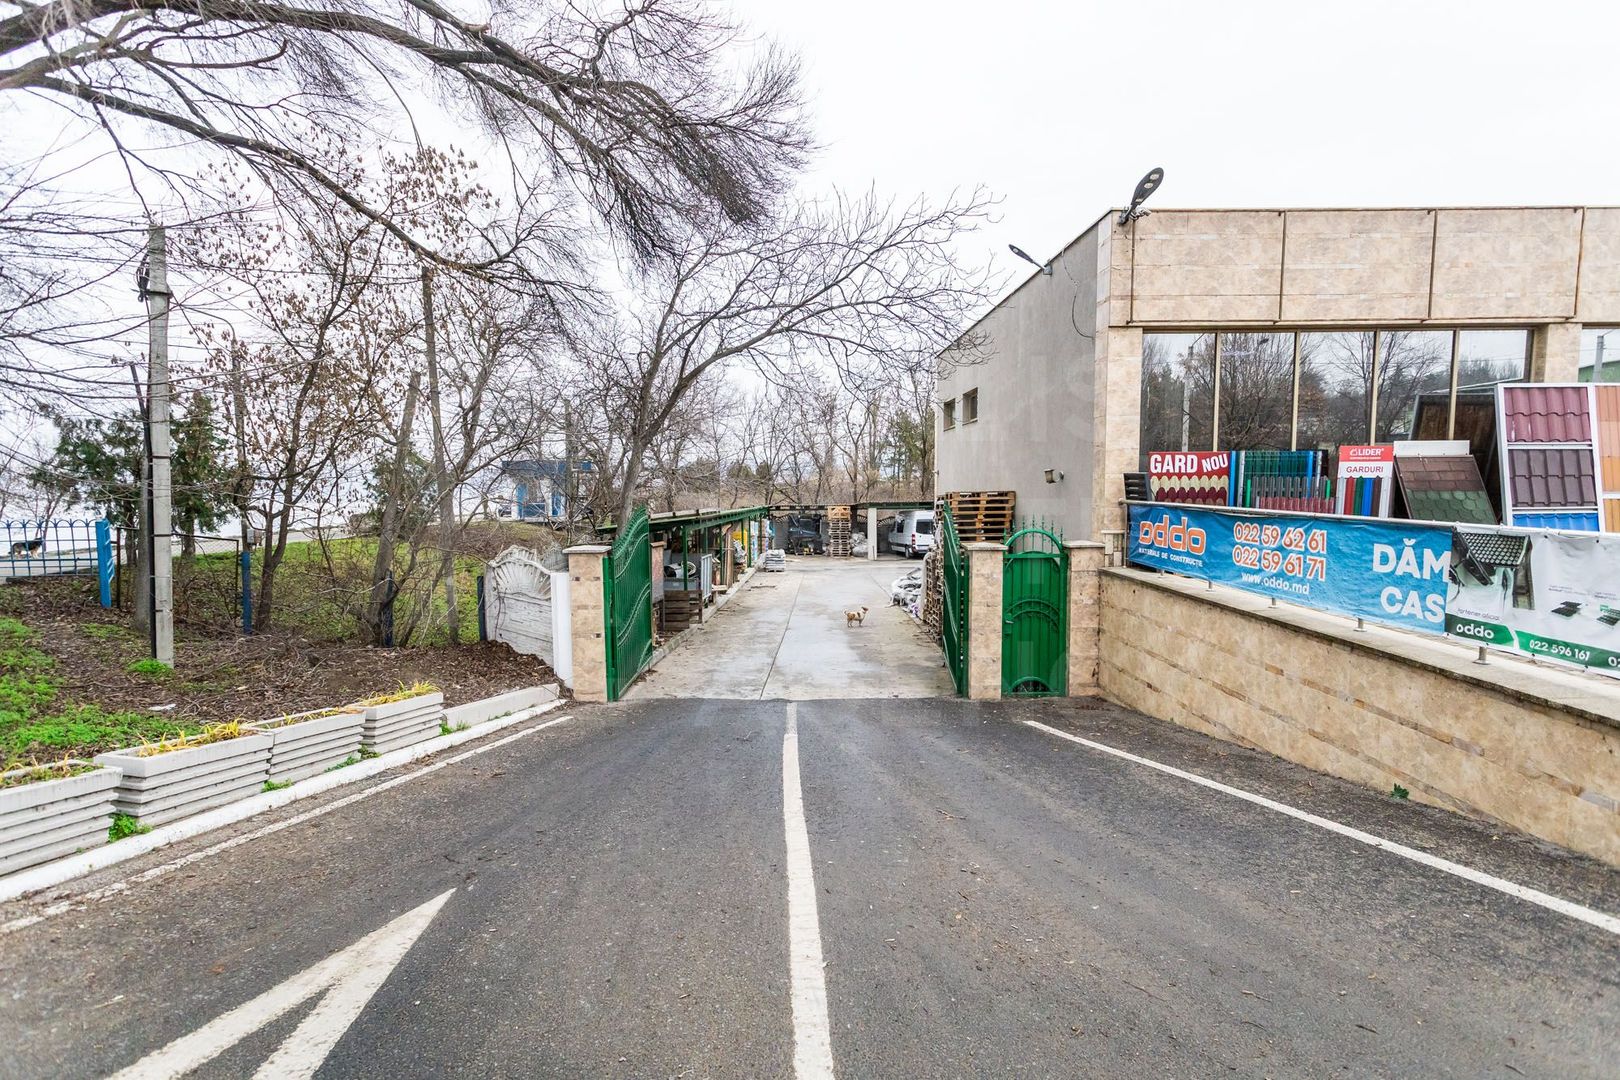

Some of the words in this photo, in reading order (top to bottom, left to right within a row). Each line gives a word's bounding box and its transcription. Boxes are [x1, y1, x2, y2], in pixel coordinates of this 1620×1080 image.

[1150, 454, 1197, 473] GARD
[1202, 454, 1229, 473] NOU
[1346, 465, 1384, 473] GARDURI
[1139, 516, 1206, 554] oddo
[1233, 522, 1259, 544] 022
[1261, 525, 1280, 547] 59
[1282, 527, 1305, 550] 62
[1307, 529, 1327, 554] 61
[1161, 552, 1169, 560] DE
[1232, 546, 1259, 568] 022
[1261, 550, 1281, 573] 59
[1283, 553, 1304, 578] 61
[1306, 556, 1326, 581] 71
[1241, 573, 1309, 594] www.oddo.md
[1456, 622, 1495, 641] oddo
[1529, 639, 1549, 653] 022
[1550, 644, 1572, 658] 596
[1574, 648, 1590, 662] 161
